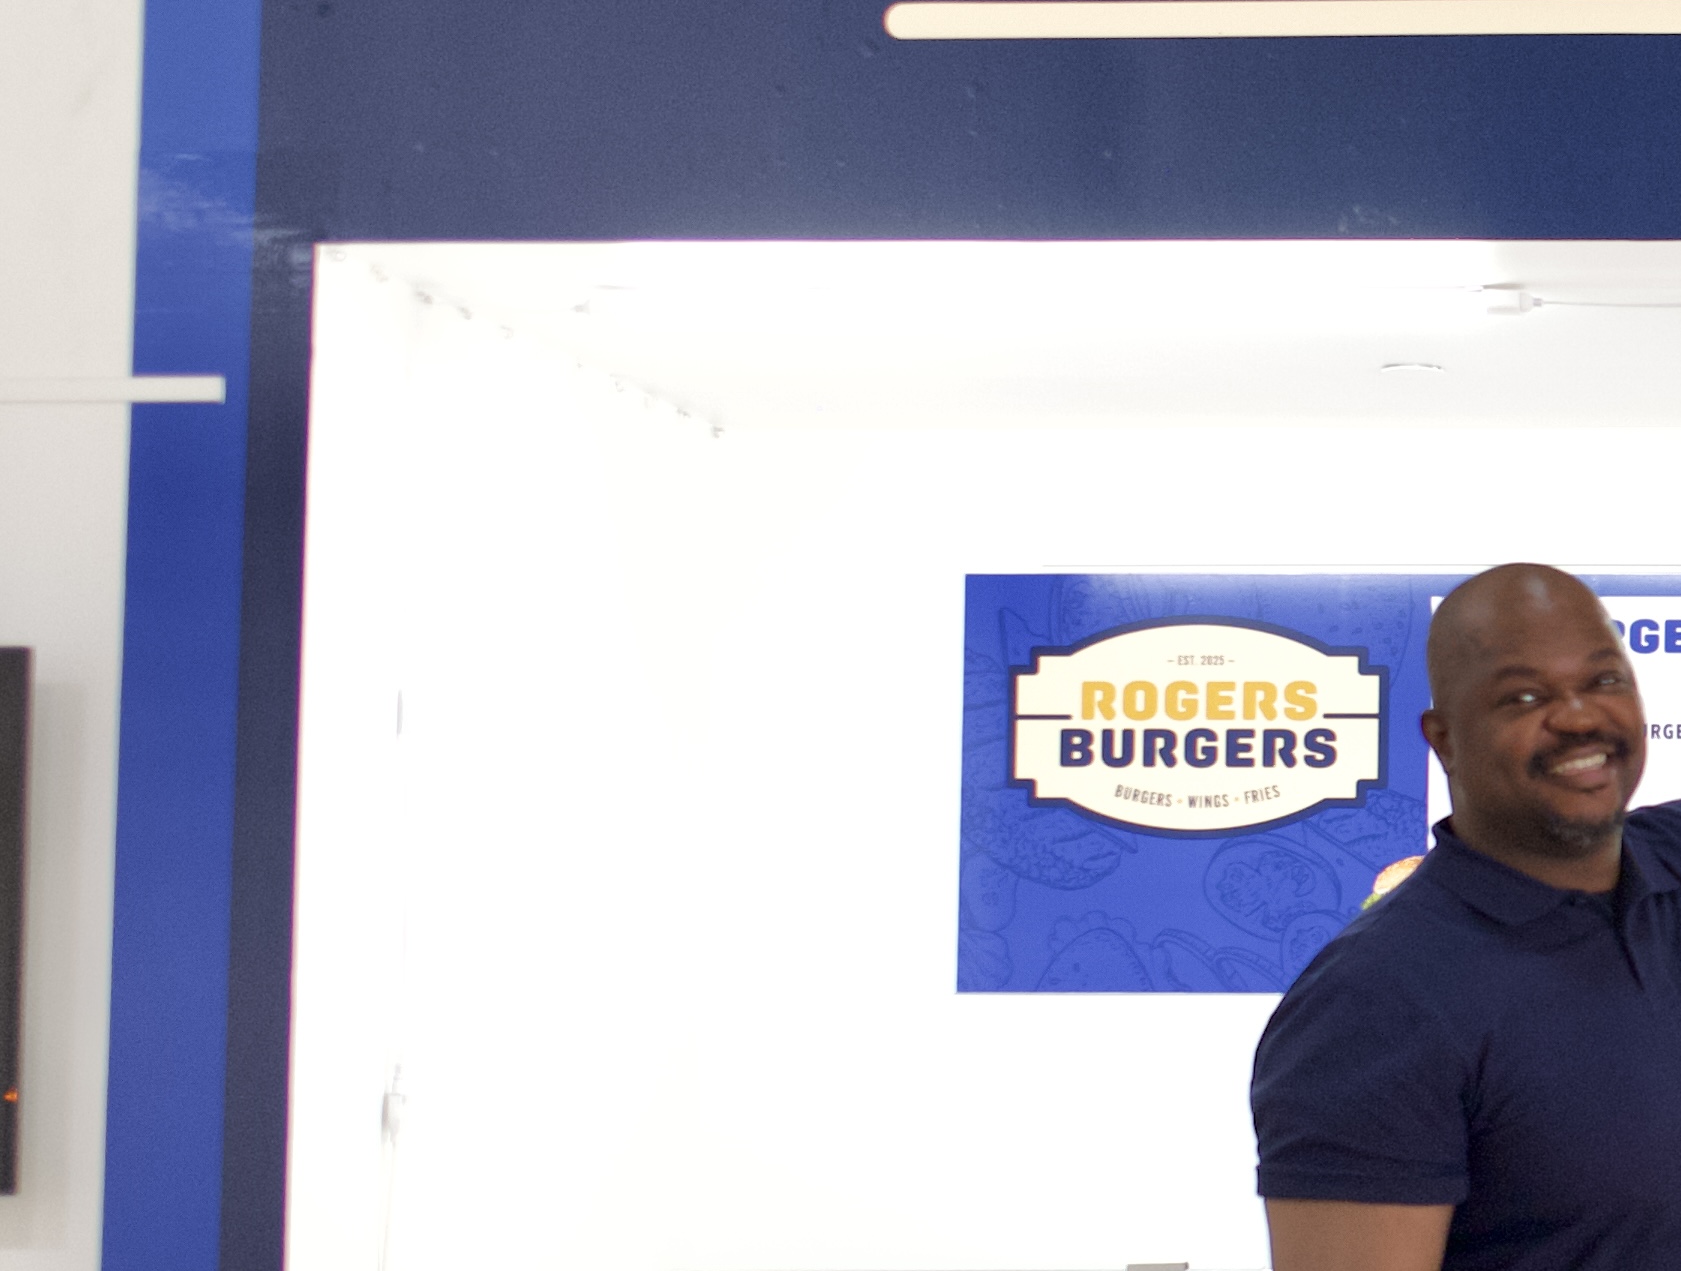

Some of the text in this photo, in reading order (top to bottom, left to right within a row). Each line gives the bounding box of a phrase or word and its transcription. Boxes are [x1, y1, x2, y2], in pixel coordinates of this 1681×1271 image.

[1081, 680, 1318, 721] ROGERS
[1059, 728, 1338, 769] BURGERS
[1114, 784, 1281, 809] BURGERS WINGS FRIES
